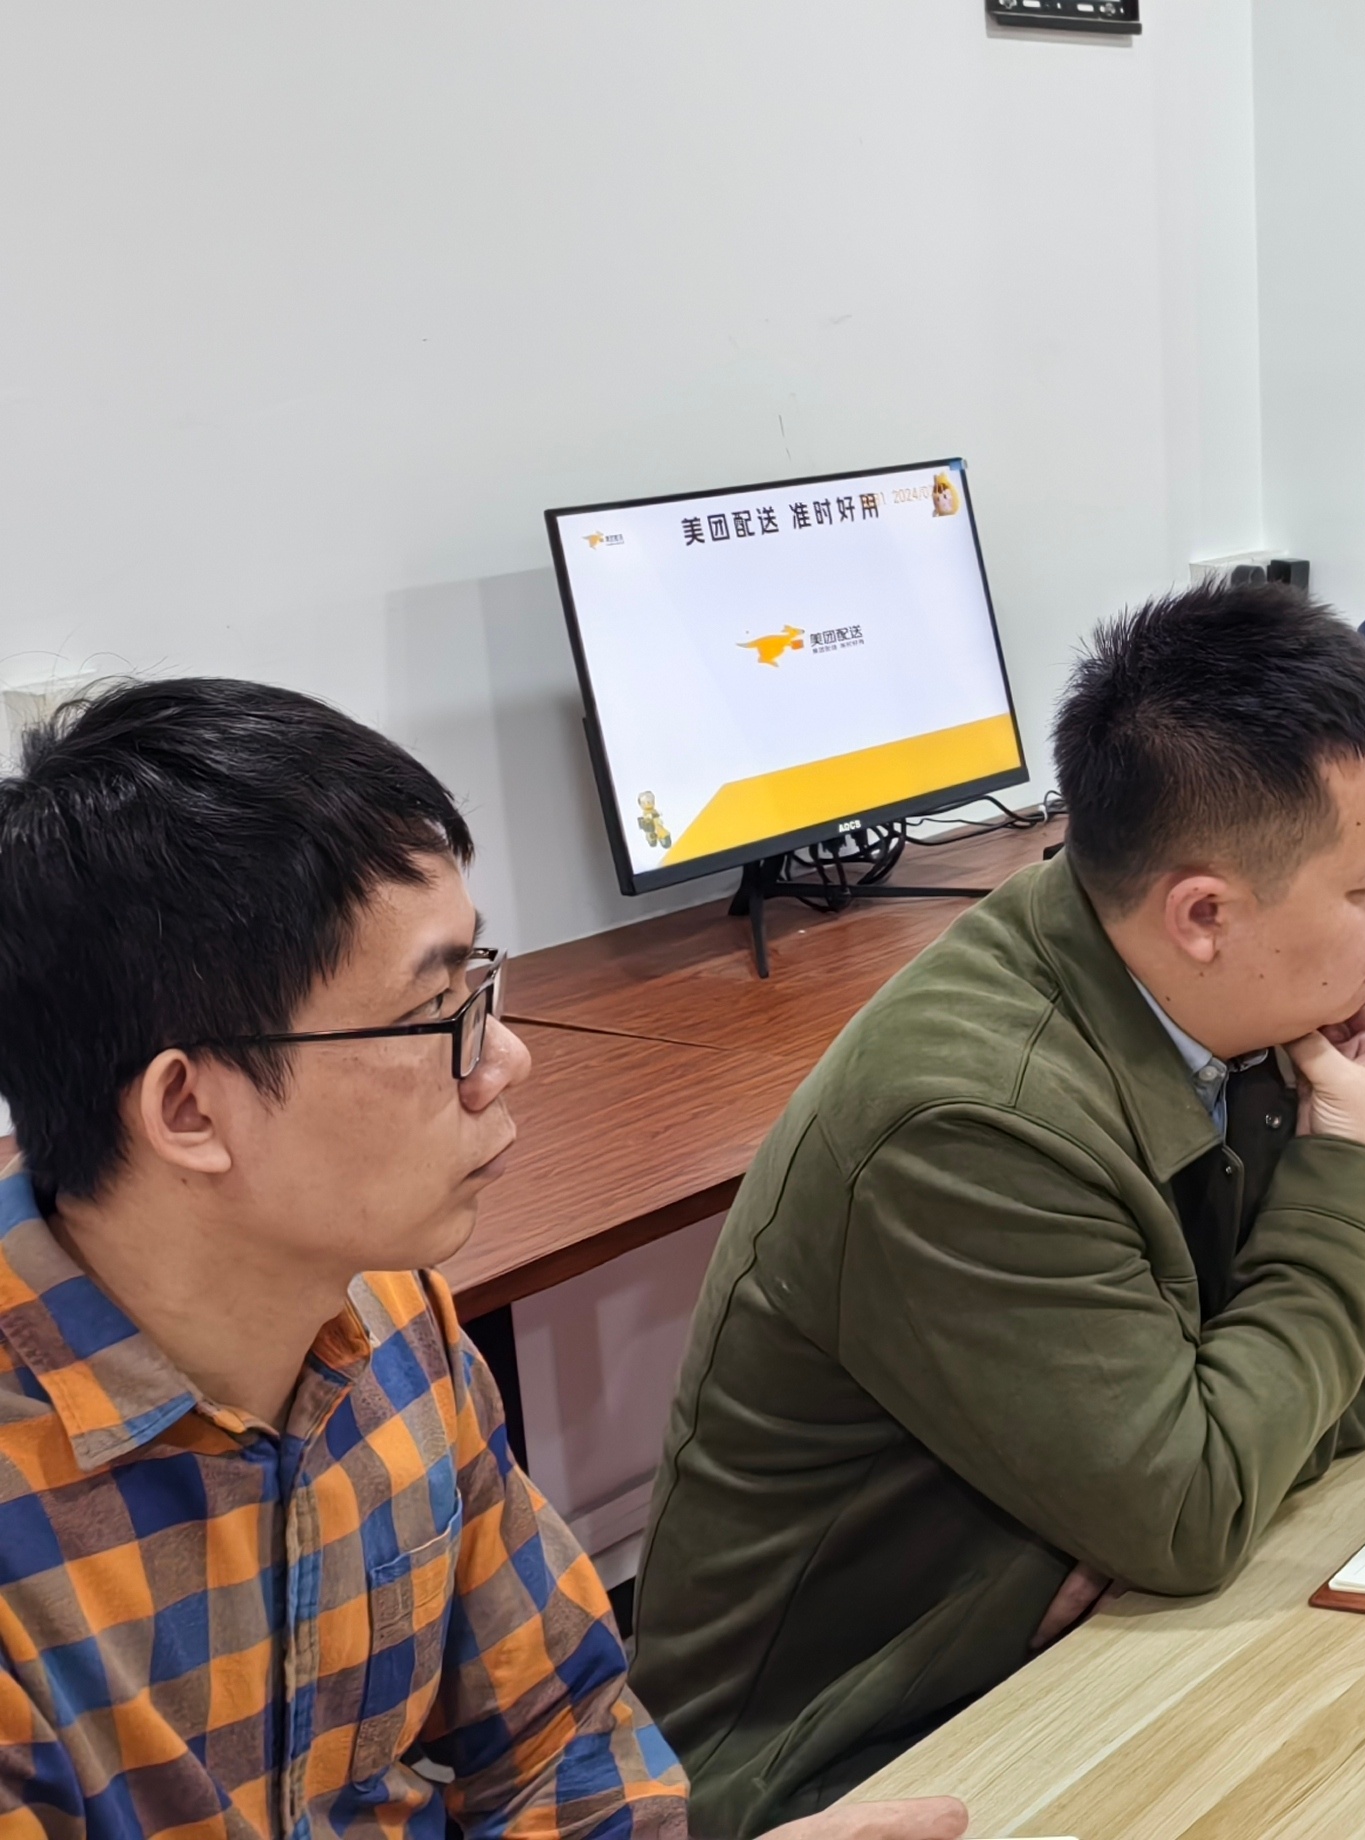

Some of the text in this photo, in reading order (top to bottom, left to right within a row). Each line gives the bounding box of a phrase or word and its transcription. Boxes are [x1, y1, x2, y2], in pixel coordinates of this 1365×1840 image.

[681, 508, 780, 546] 美团配送
[789, 493, 881, 529] 准时好用
[810, 625, 863, 647] 美团配送
